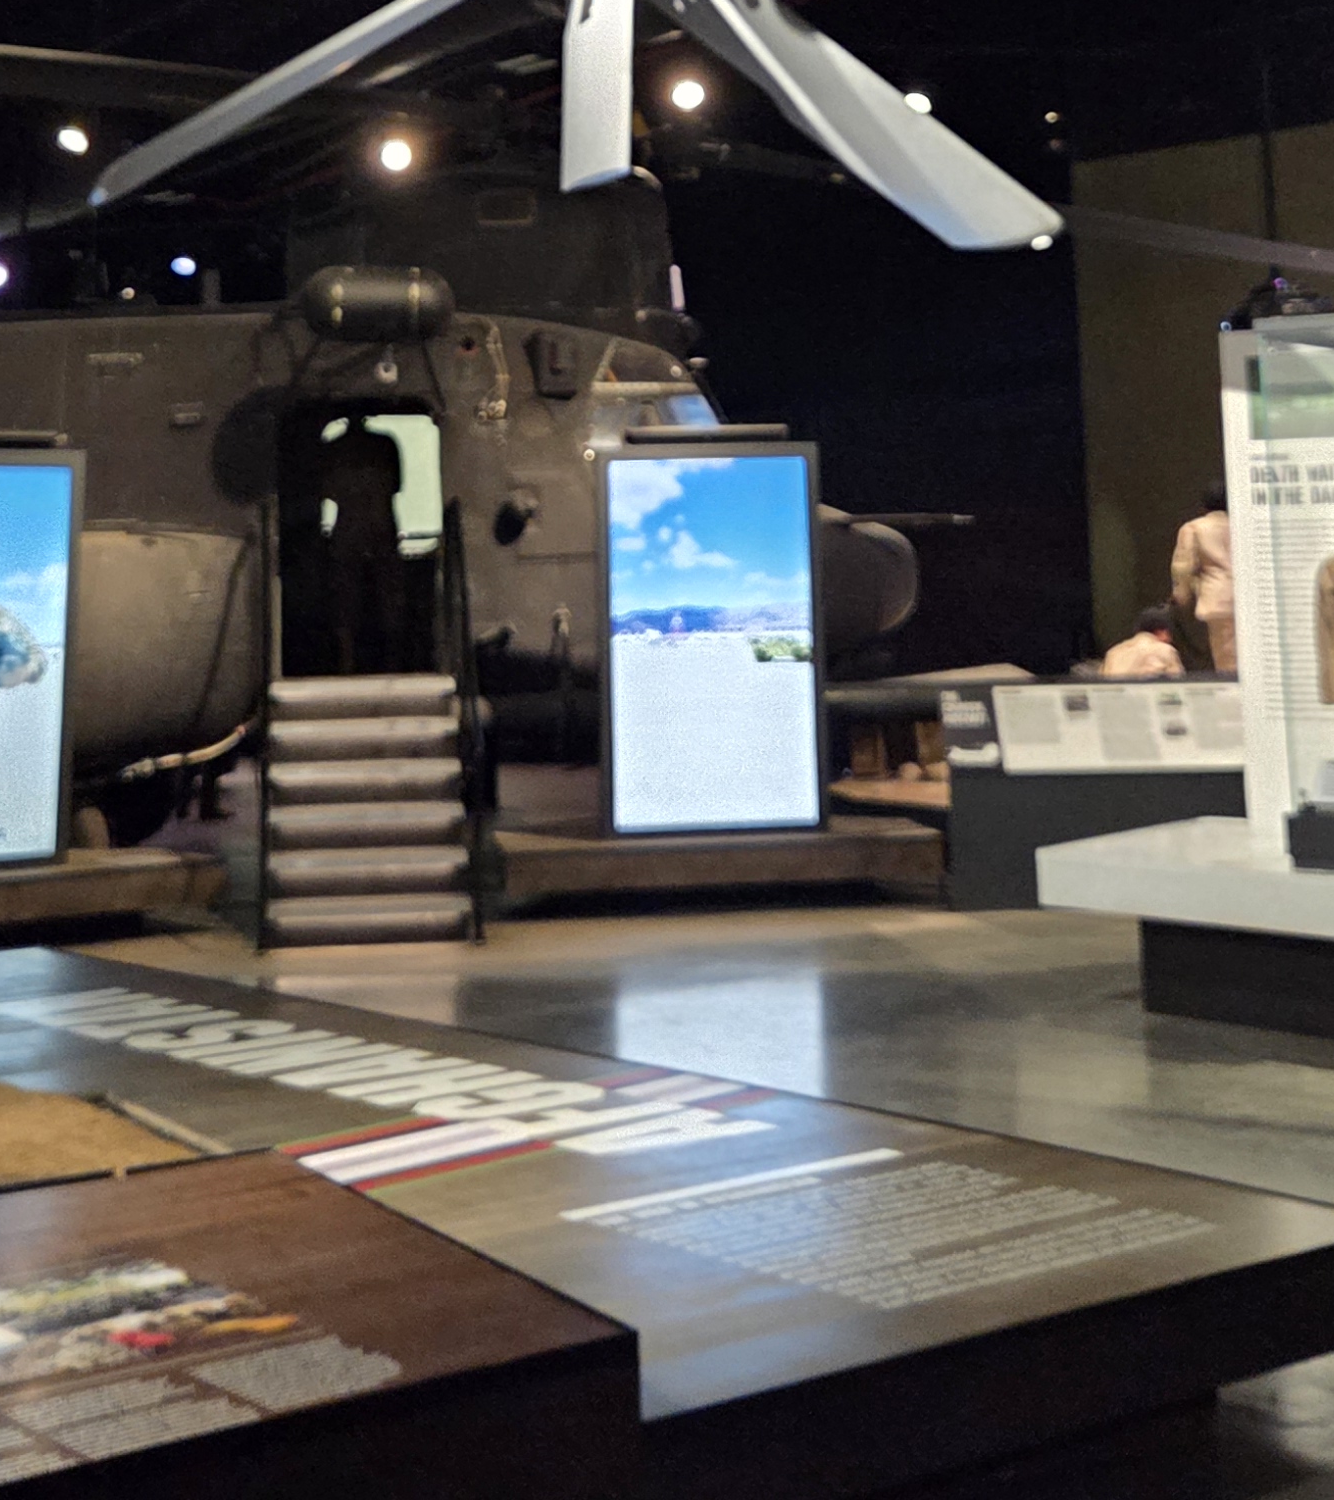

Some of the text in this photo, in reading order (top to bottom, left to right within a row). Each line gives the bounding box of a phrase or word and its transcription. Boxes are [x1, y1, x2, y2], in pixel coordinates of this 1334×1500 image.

[1250, 464, 1299, 484] DEATH
[1251, 487, 1267, 505] IN
[1269, 485, 1303, 505] THE
